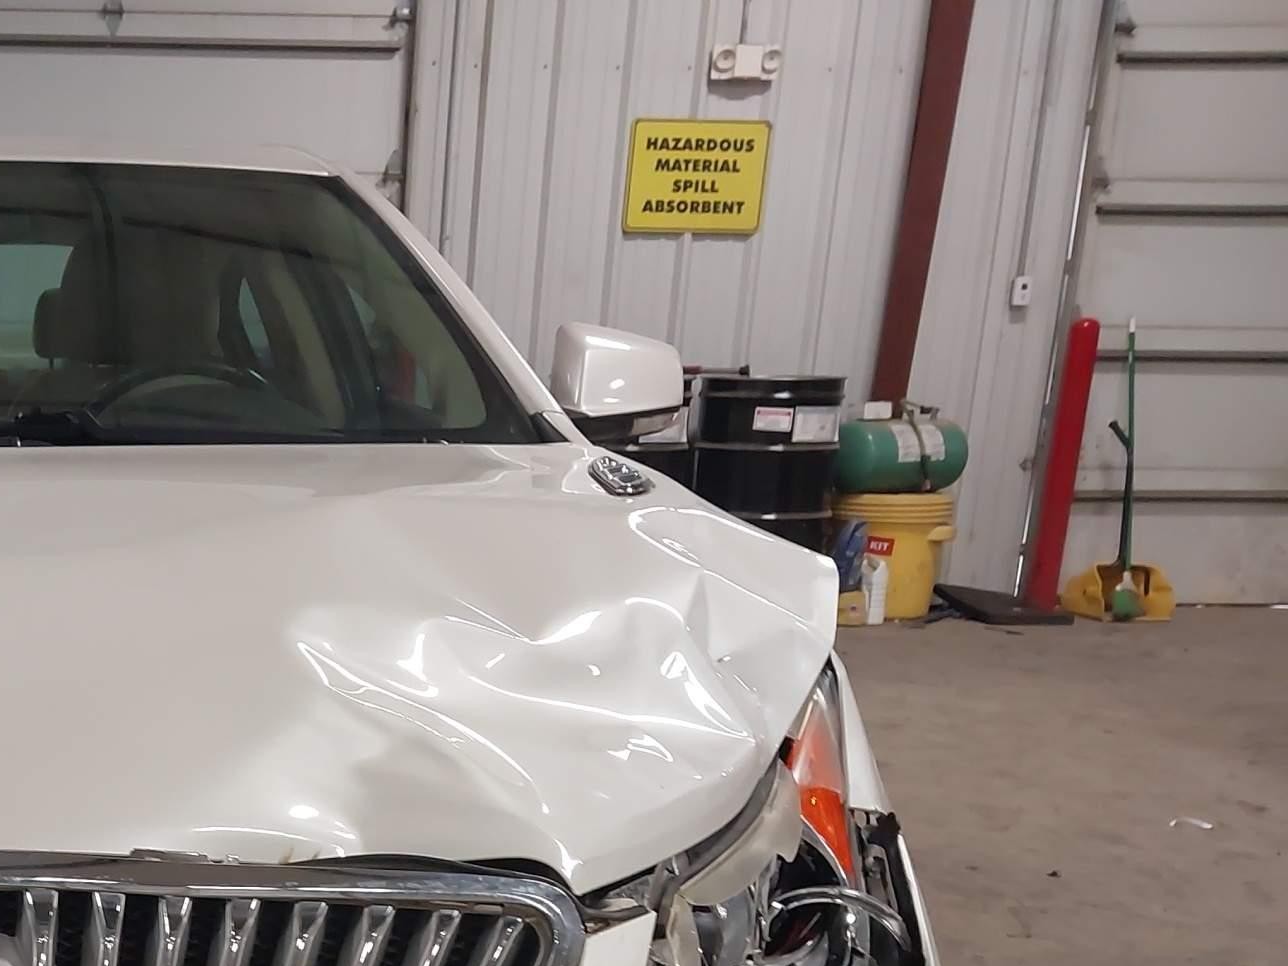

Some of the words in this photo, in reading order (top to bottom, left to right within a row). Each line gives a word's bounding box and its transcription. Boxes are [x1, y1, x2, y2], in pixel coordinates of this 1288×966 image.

[646, 137, 755, 152] HAZARDOUS
[654, 158, 741, 173] MATERIAL
[672, 179, 719, 193] SPILL
[641, 200, 745, 214] ABSORBENT
[870, 540, 889, 551] KIT
